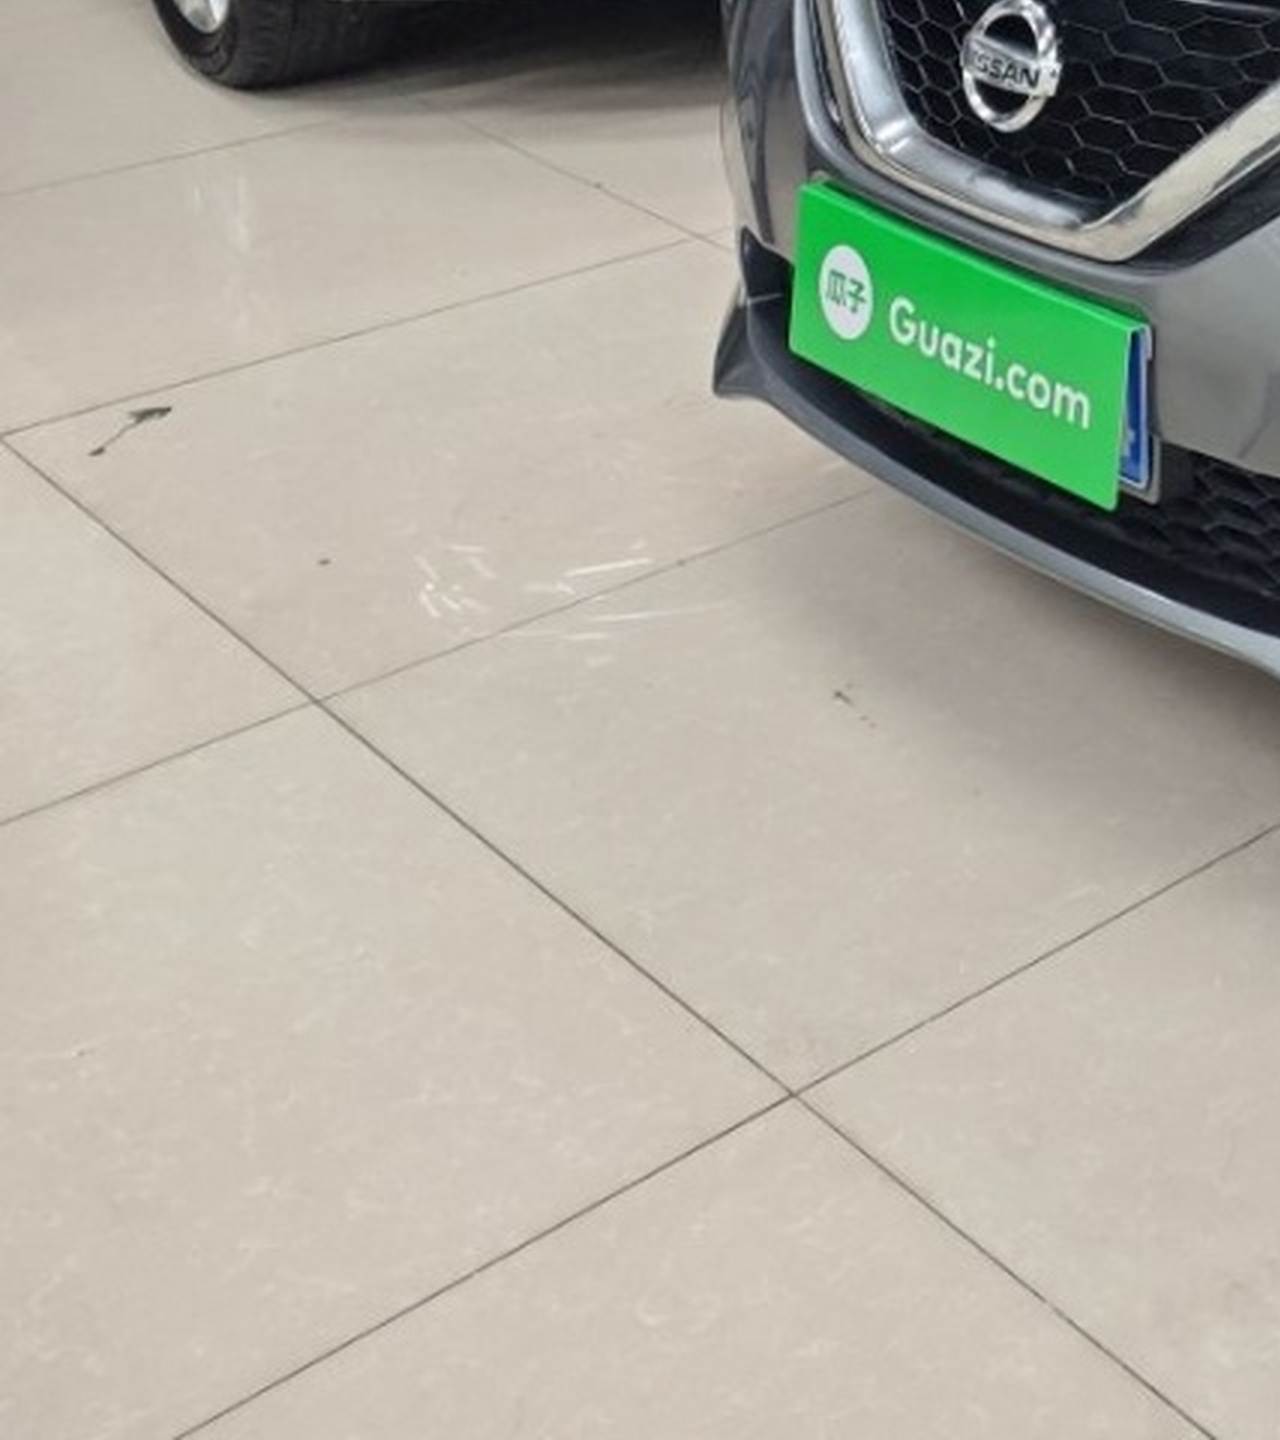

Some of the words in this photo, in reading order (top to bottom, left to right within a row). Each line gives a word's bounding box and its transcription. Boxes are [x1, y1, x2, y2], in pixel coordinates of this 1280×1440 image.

[967, 41, 1041, 89] SSAN
[825, 268, 868, 314] 瓜子
[889, 295, 1091, 430] Guazi.com
